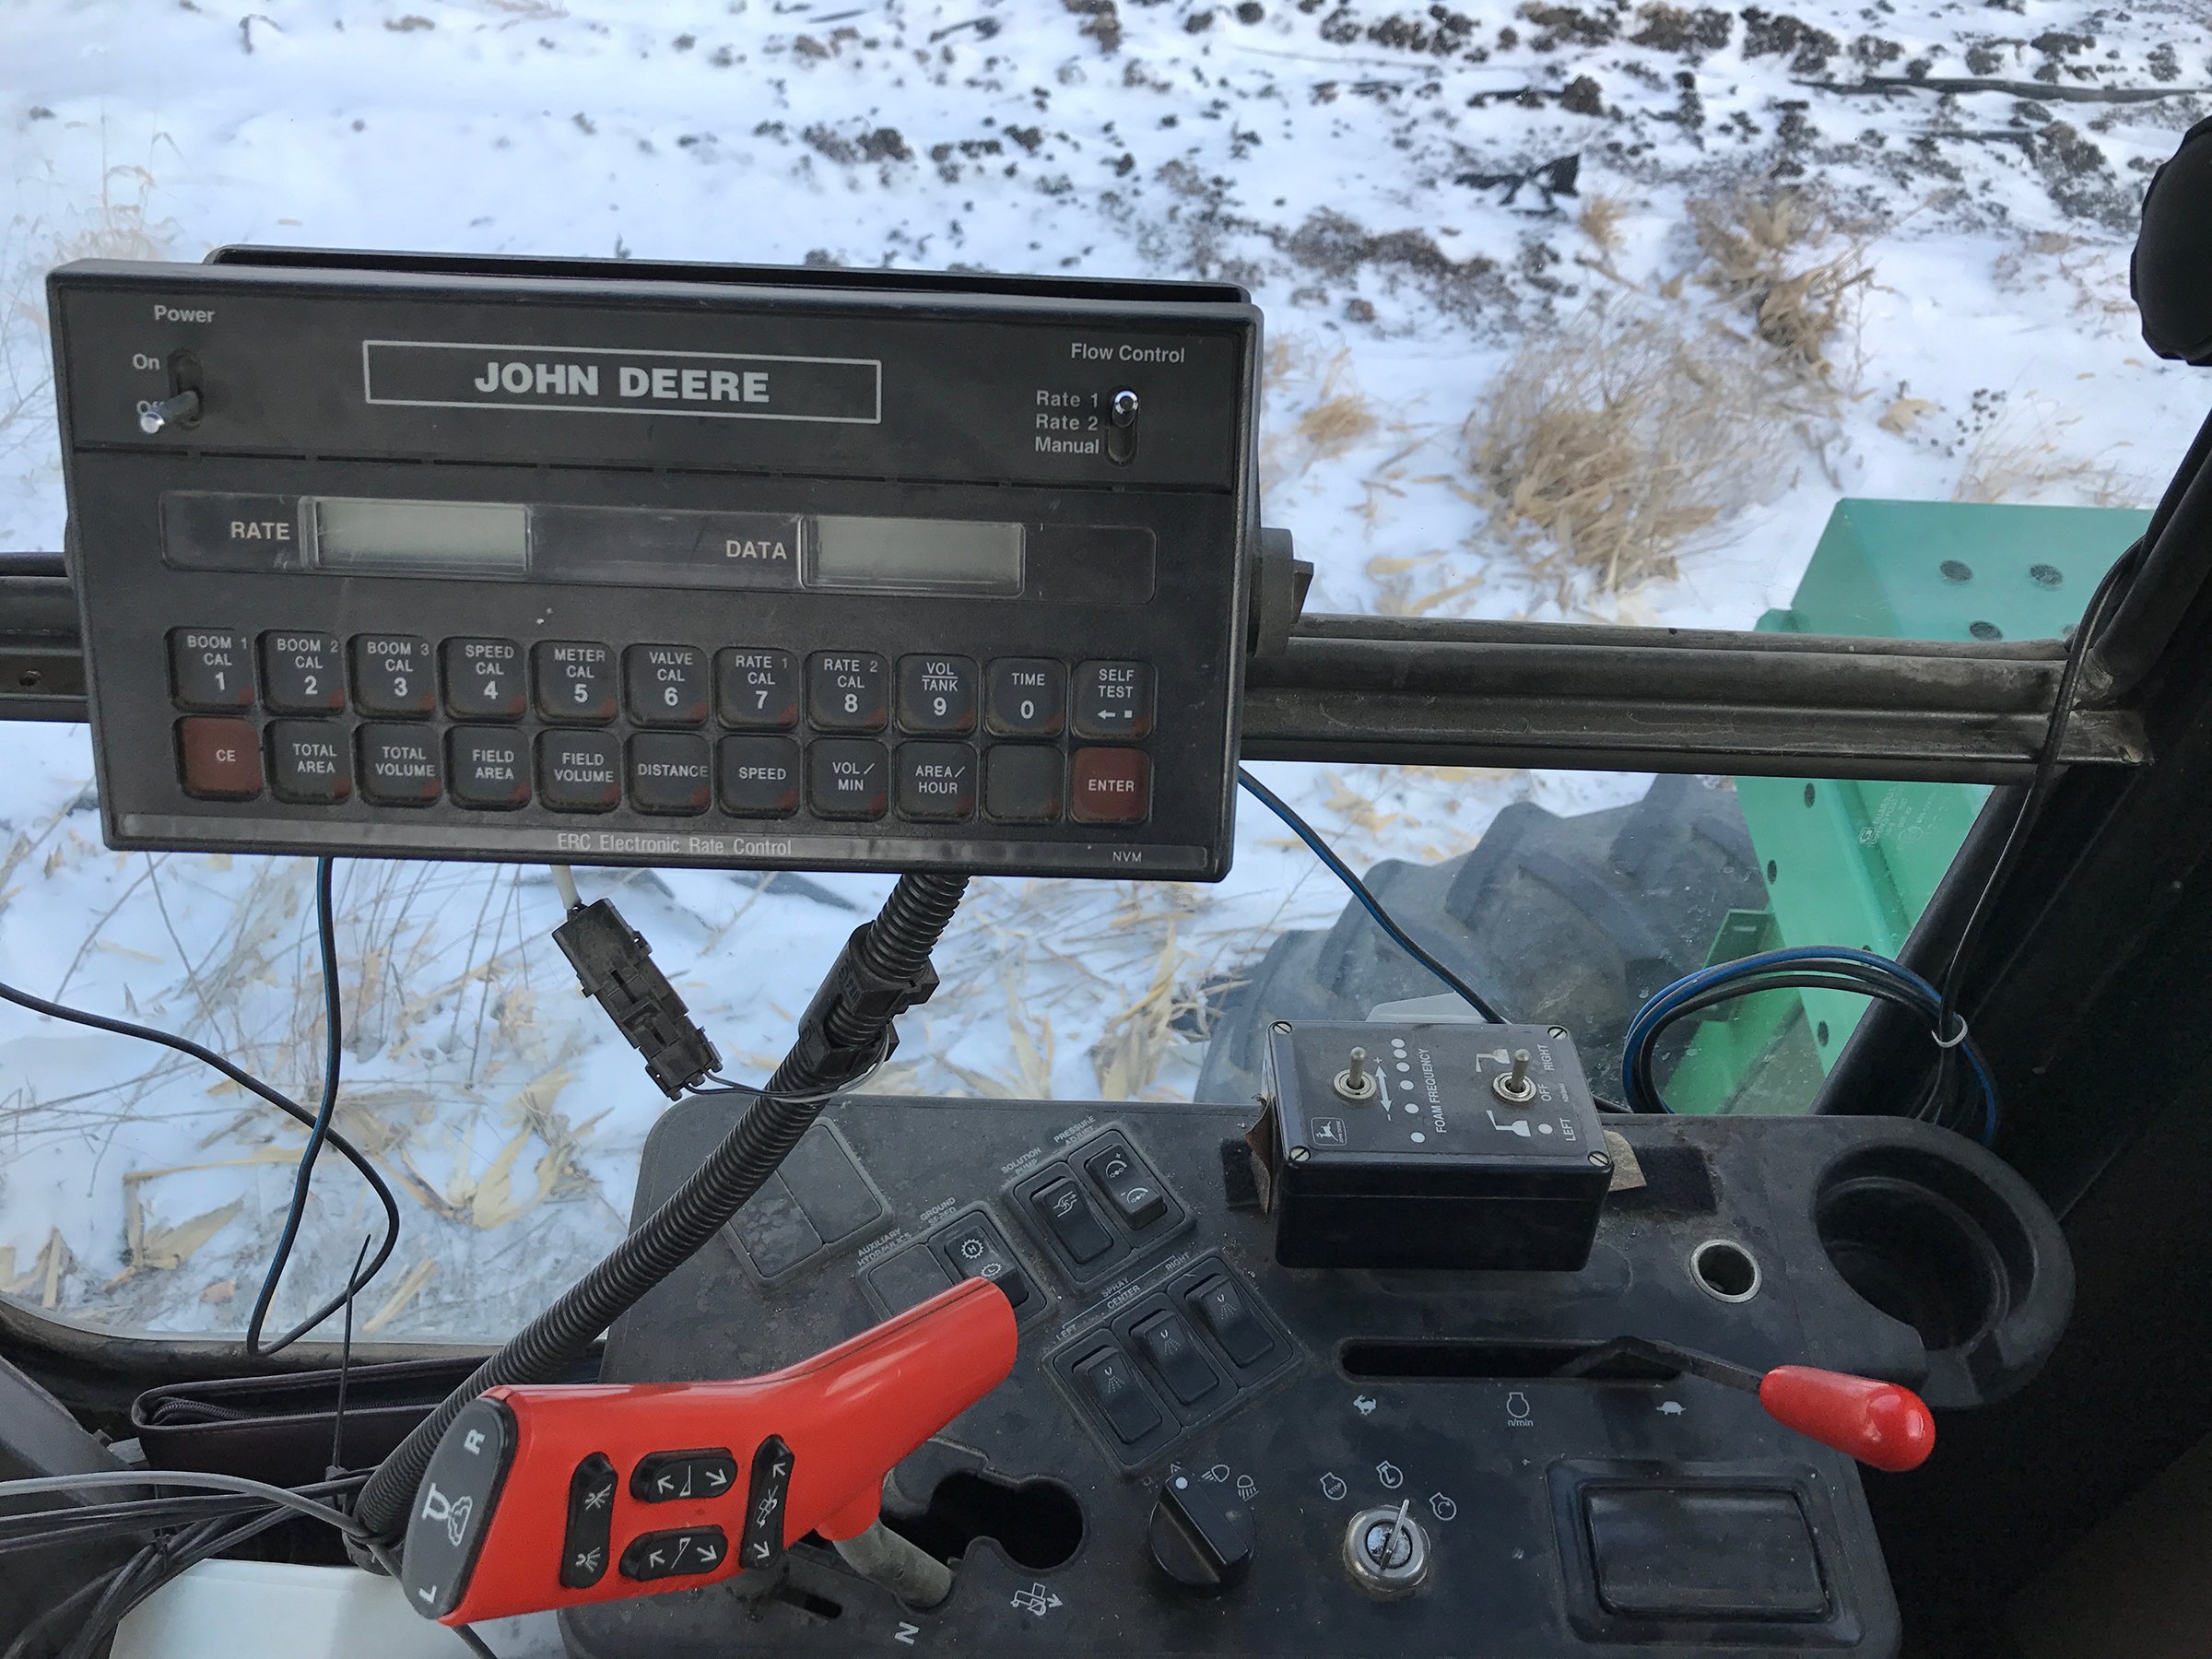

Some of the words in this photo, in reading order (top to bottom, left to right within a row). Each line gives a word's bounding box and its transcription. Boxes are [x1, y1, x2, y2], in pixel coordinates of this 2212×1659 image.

[153, 305, 216, 324] Power
[1071, 343, 1113, 360] Flow
[1119, 345, 1185, 363] Control
[133, 353, 160, 370] On
[475, 361, 598, 395] JOHN
[619, 367, 770, 403] DEERE
[1036, 390, 1081, 407] Rate
[1090, 393, 1099, 407] 1
[1036, 414, 1080, 430] Rate
[1088, 416, 1099, 431] 2
[1035, 436, 1100, 453] Manual
[230, 521, 290, 540] RATE
[725, 539, 787, 560] DATA
[187, 635, 231, 648] BOOM
[241, 637, 247, 650] 1
[277, 639, 321, 652] BOOM
[330, 640, 339, 653] 2
[368, 641, 411, 655] BOOM
[420, 643, 429, 655] 3
[204, 653, 232, 665] CAL
[465, 645, 514, 658] SPEED
[554, 649, 606, 662] METER
[649, 652, 693, 665] VALVE
[295, 656, 323, 669] CAL
[385, 659, 414, 672] CAL
[476, 662, 504, 676] CAL
[735, 655, 772, 668] RATE
[782, 657, 787, 668] 1
[824, 659, 860, 672] RATE
[869, 661, 878, 672] 2
[566, 665, 594, 678] CAL
[657, 668, 686, 682] CAL
[926, 663, 954, 676] VOL
[1099, 668, 1135, 682] SELF
[215, 672, 225, 690] 1
[304, 676, 318, 695] 2
[747, 672, 775, 685] CAL
[837, 676, 865, 688] CAL
[922, 679, 959, 691] TANK
[1012, 673, 1045, 686] TIME
[394, 677, 408, 697] 3
[484, 680, 499, 700] 4
[574, 684, 588, 702] 5
[1099, 686, 1134, 699] TEST
[665, 687, 678, 706] 6
[756, 690, 769, 709] 7
[844, 694, 858, 712] 8
[933, 697, 947, 716] 9
[1020, 700, 1034, 719] 0
[216, 749, 236, 762] CE
[293, 743, 337, 757] TOTAL
[382, 746, 427, 760] TOTAL
[472, 749, 514, 762] FIELD
[297, 760, 335, 773] AREA
[562, 752, 605, 766] FIELD
[376, 763, 436, 777] VOLUME
[475, 767, 514, 780] AREA
[554, 770, 614, 782] VOLUME
[638, 764, 708, 777] DISTANCE
[739, 767, 786, 780] SPEED
[838, 780, 864, 791] MIN
[919, 782, 958, 794] HOUR
[1088, 779, 1135, 792] ENTER
[557, 833, 591, 850] ERC
[600, 835, 679, 853] Electronic
[689, 837, 724, 853] Rate
[733, 839, 792, 855] Control
[1112, 851, 1142, 864] NVM
[1537, 1044, 1555, 1071] RIGHT
[1418, 1048, 1441, 1103] FREQUENCY
[1537, 1083, 1552, 1101] OFF
[1431, 1105, 1447, 1134] FOAM
[1053, 1115, 1096, 1143] PRESSURE
[1065, 1125, 1095, 1147] ADJUST
[1559, 1117, 1576, 1141] LEFT
[1001, 1147, 1041, 1173] SOLUTION
[1015, 1159, 1038, 1175] PUMP
[920, 1197, 957, 1221] GROUND
[858, 1228, 901, 1257] AUXILIARY
[968, 1244, 977, 1253] H
[1165, 1252, 1191, 1272] RIGHT
[1101, 1277, 1130, 1298] SPRAY
[1107, 1285, 1141, 1309] CENTER
[1055, 1324, 1077, 1340] LEFT
[1507, 1418, 1534, 1427] n/min
[464, 1428, 486, 1455] R
[1328, 1481, 1342, 1495] STOP
[418, 1585, 437, 1604] L
[894, 1621, 920, 1645] N
